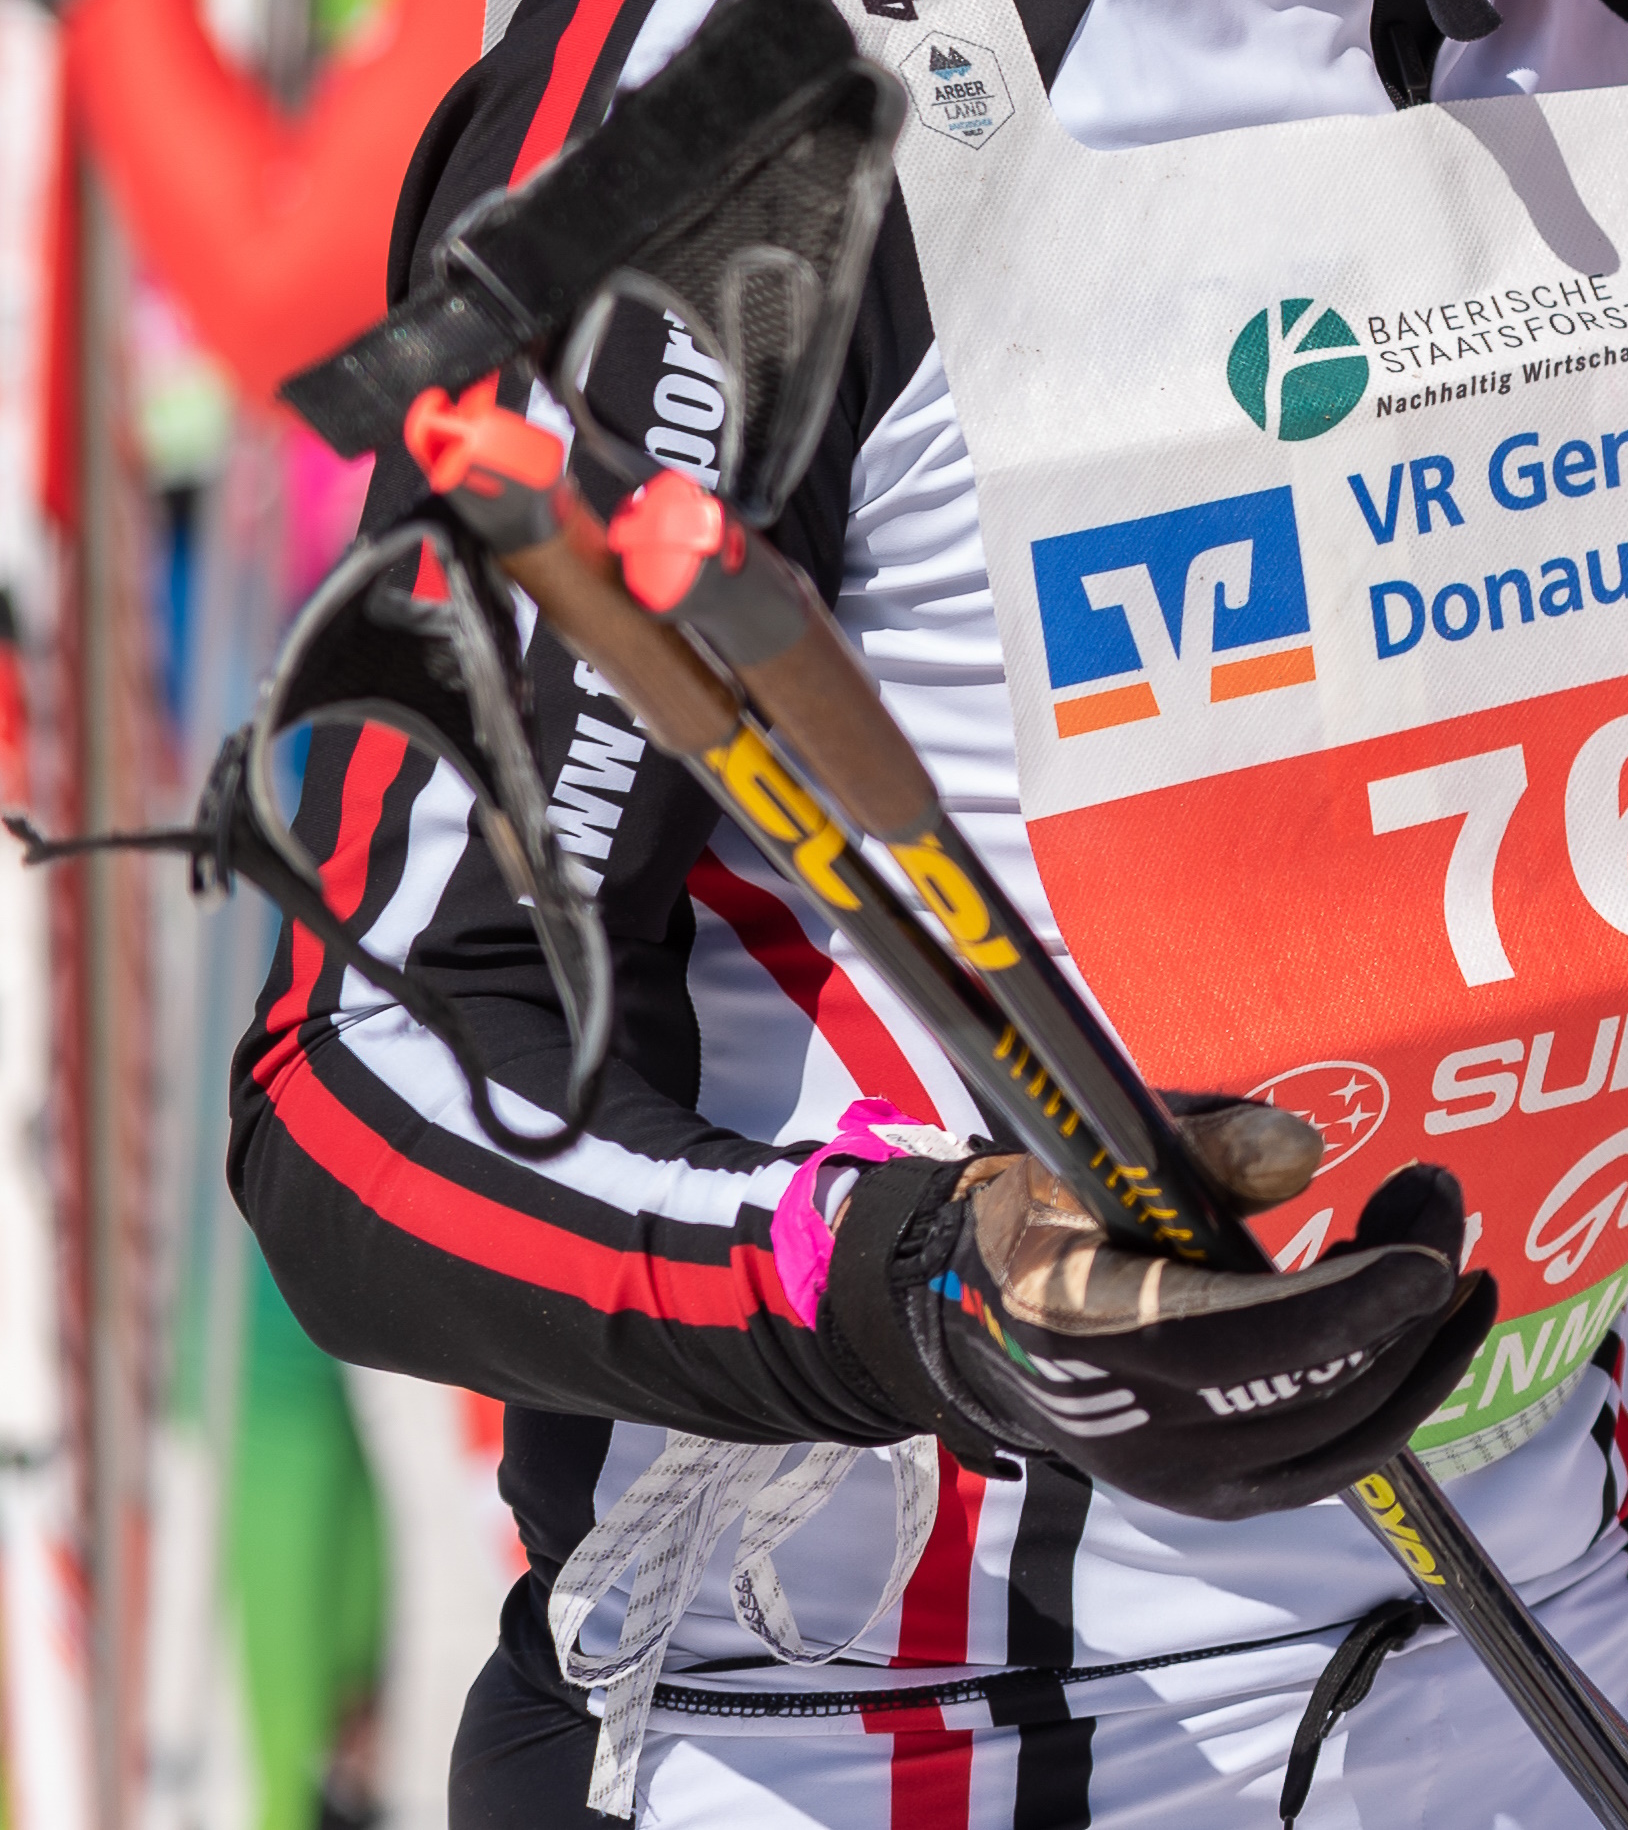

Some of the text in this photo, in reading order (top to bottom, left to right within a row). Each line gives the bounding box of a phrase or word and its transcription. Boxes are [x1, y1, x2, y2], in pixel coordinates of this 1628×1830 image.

[933, 81, 988, 103] ARBER
[944, 100, 988, 121] LAND
[1367, 273, 1614, 346] BAYERISCHE
[1375, 370, 1512, 419] Nachhaltig
[1347, 454, 1465, 546] VR
